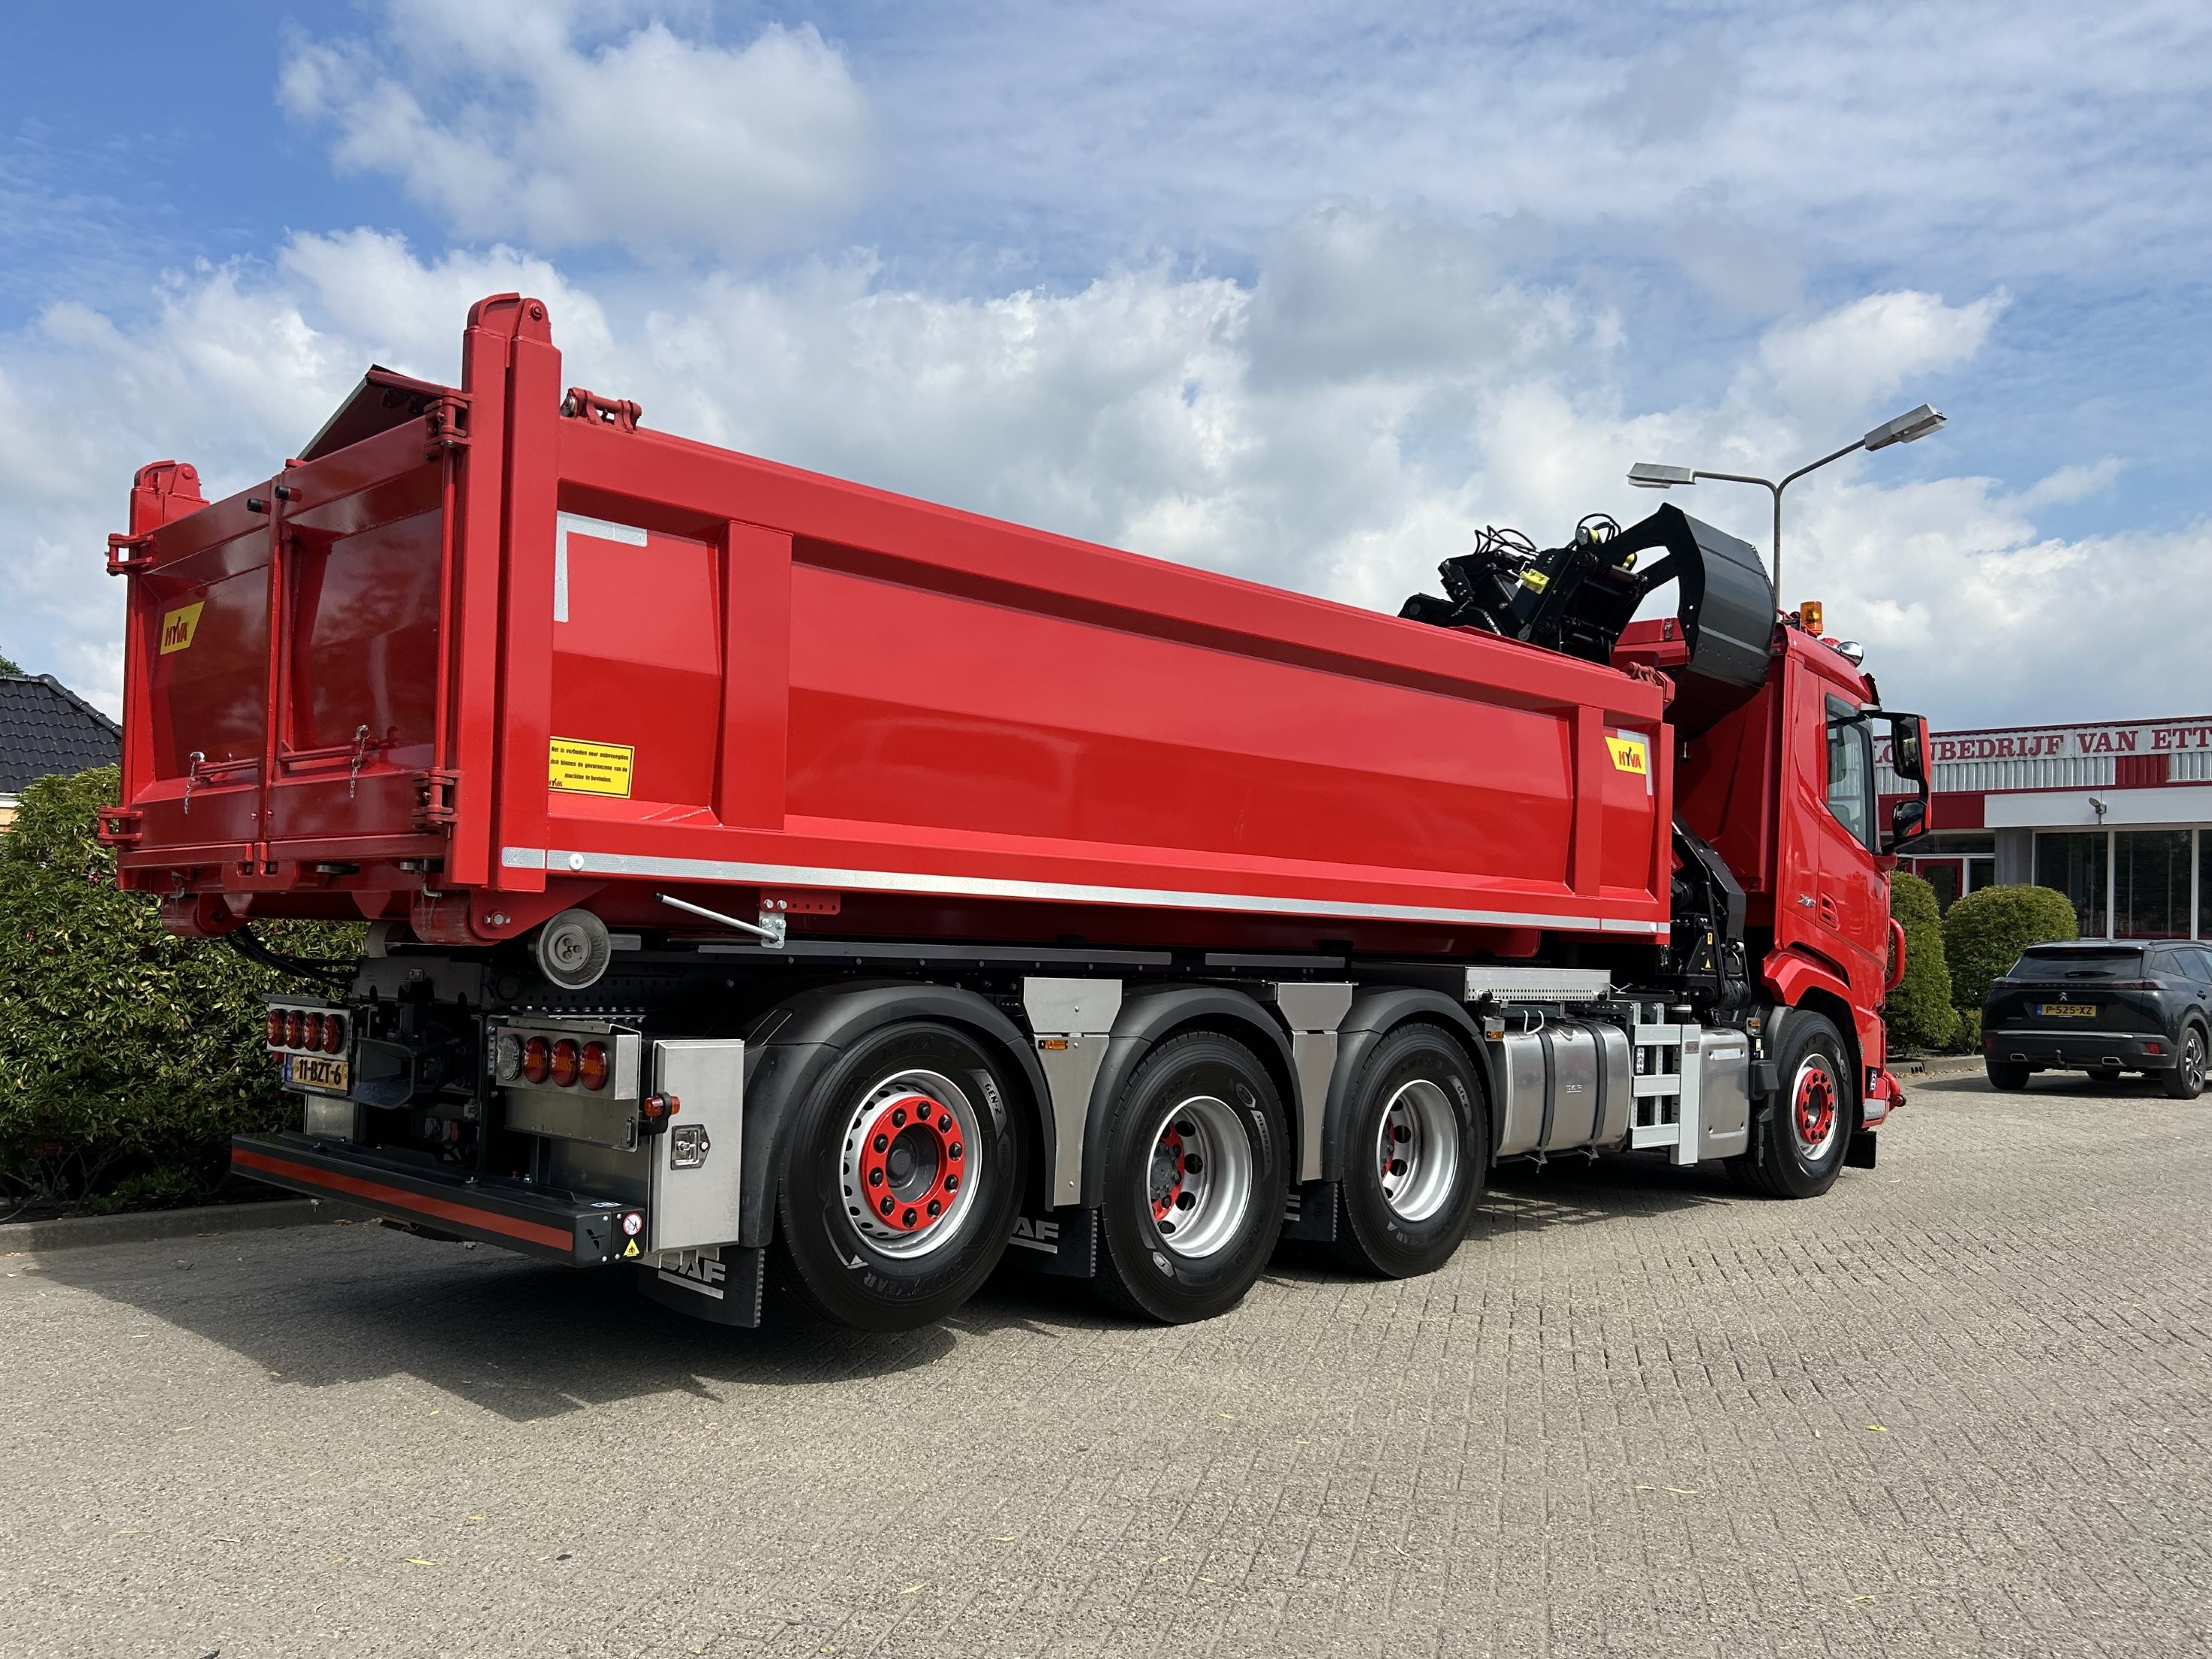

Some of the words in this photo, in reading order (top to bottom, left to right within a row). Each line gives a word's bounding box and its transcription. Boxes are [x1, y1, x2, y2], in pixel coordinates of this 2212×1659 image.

[165, 615, 187, 646] HYVA
[1874, 735, 2064, 763] OBEDRIJF
[2077, 731, 2138, 752] VAN
[2151, 726, 2212, 749] ETT
[1618, 747, 1642, 769] HYVA
[2046, 1006, 2092, 1015] P-525-XZ
[299, 1059, 342, 1085] 11-BZT-6
[985, 1083, 1002, 1115] GEN-2
[1012, 1216, 1059, 1240] AF
